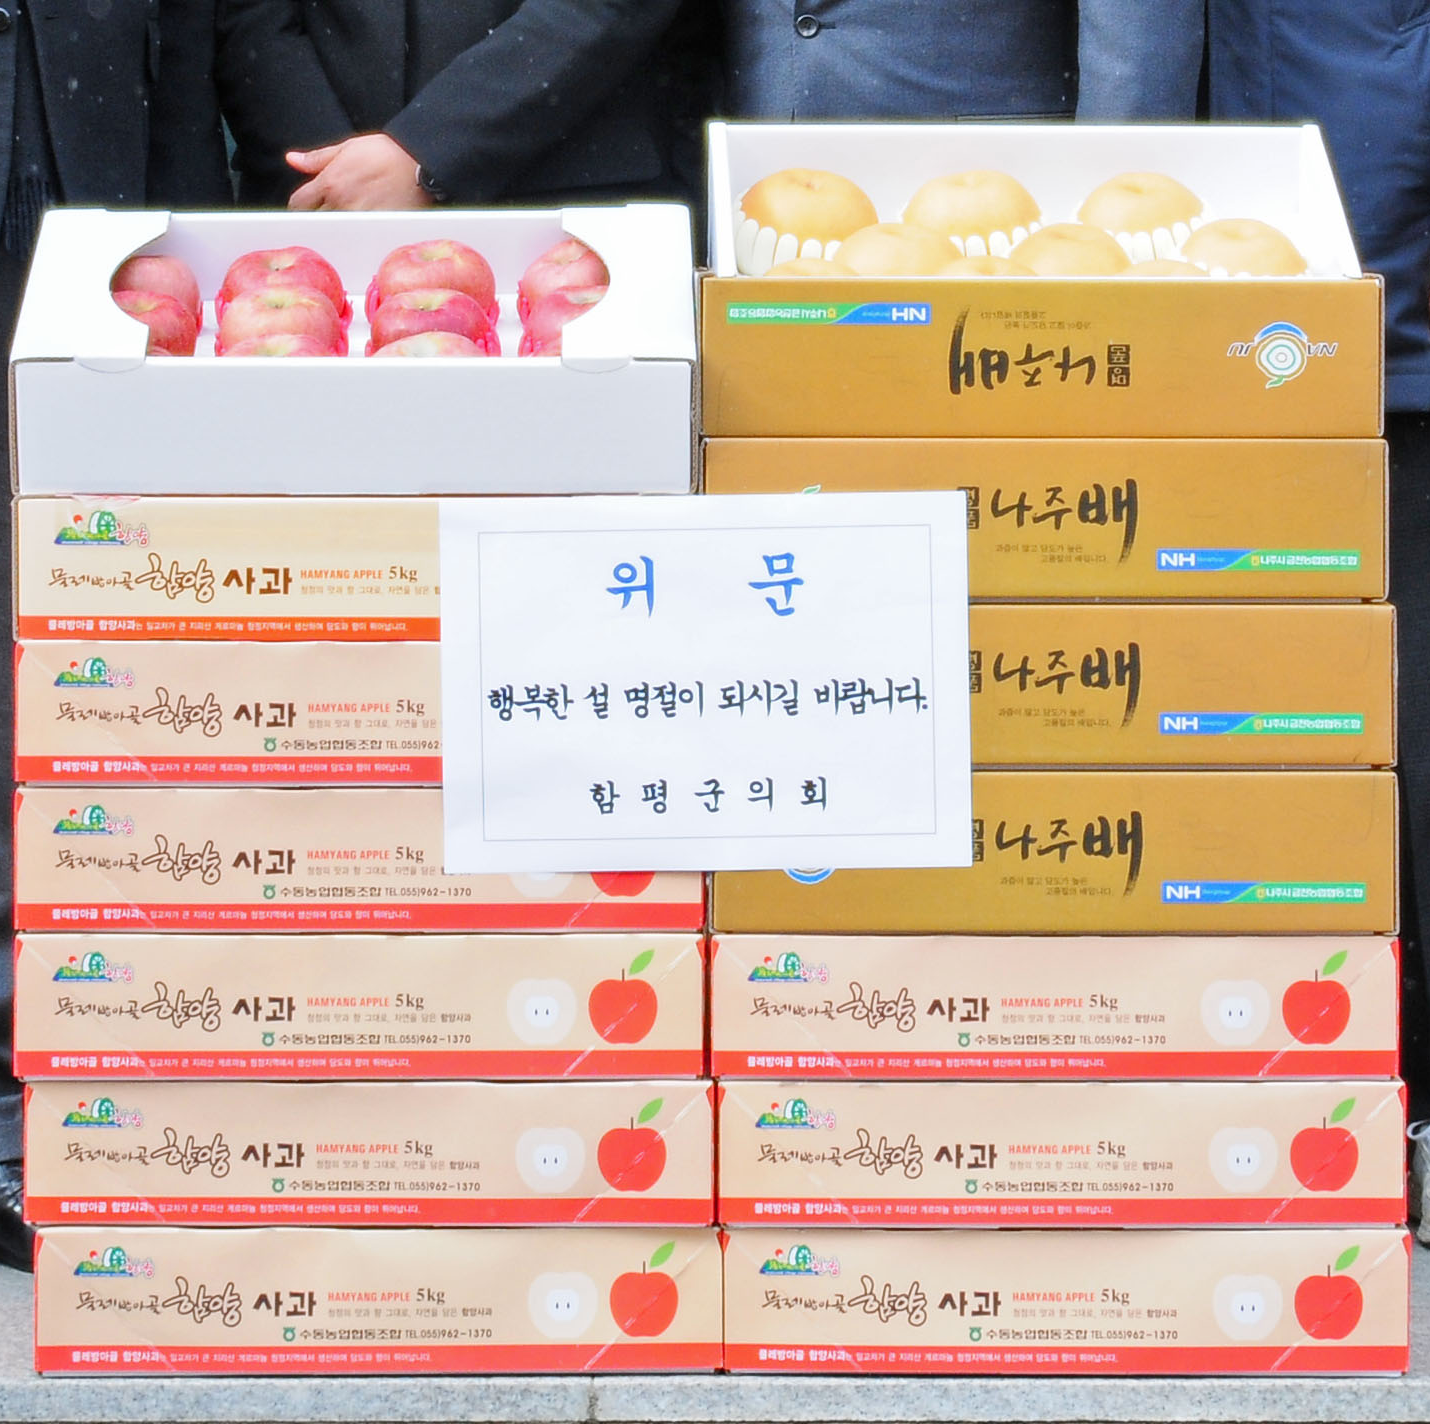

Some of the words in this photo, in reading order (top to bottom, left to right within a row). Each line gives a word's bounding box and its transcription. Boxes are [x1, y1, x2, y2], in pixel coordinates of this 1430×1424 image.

[891, 307, 926, 321] NH
[949, 307, 1096, 395] 나주배
[1106, 343, 1131, 388] 명품
[990, 478, 1138, 566] 나주배
[1160, 552, 1196, 567] NH
[222, 567, 293, 596] 사과
[300, 569, 350, 579] HAMYANG
[353, 569, 384, 579] APPLE
[388, 565, 418, 583] 5kg
[606, 555, 654, 617] 위
[749, 552, 804, 617] 문
[993, 641, 1141, 729] 나주배
[308, 703, 358, 713] HAMYANG
[360, 703, 391, 713] APPLE
[396, 699, 426, 717] 5kg
[487, 683, 574, 722] 행복한
[583, 682, 609, 720] 설
[624, 680, 704, 719] 명절이
[718, 678, 799, 717] 되시길
[813, 676, 928, 715] 바랍니다.
[233, 703, 297, 729] 사과
[1163, 716, 1199, 731] NH
[281, 740, 383, 751] 수동농업협동조합
[589, 780, 620, 815] 함
[642, 778, 668, 815] 평
[694, 778, 725, 813] 군
[747, 777, 774, 811] 의
[800, 776, 827, 811] 회
[232, 850, 296, 876] 사과
[307, 850, 357, 860] HAMYANG
[359, 850, 390, 860] APPLE
[395, 846, 425, 864] 5kg
[995, 810, 1143, 898] 나주배
[280, 887, 382, 898] 수동농업협동조합
[1165, 885, 1201, 900] NH
[232, 997, 296, 1023] 사과
[307, 997, 357, 1007] HAMYANG
[359, 997, 390, 1007] APPLE
[395, 993, 425, 1011] 5kg
[926, 998, 990, 1024] 사과
[1001, 998, 1051, 1008] HAMYANG
[1053, 998, 1084, 1008] APPLE
[1089, 994, 1119, 1012] 5kg
[279, 1034, 381, 1045] 수동농업협동조합
[974, 1034, 1076, 1045] 수동농업협동조합
[241, 1143, 305, 1169] 사과
[316, 1144, 366, 1154] HAMYANG
[368, 1144, 399, 1154] APPLE
[404, 1140, 434, 1158] 5kg
[934, 1144, 998, 1170] 사과
[1009, 1144, 1059, 1154] HAMYANG
[1061, 1144, 1092, 1154] APPLE
[1097, 1141, 1127, 1159] 5kg
[289, 1180, 391, 1191] 수동농업협동조합
[982, 1181, 1084, 1192] 수동농업협동조합
[253, 1292, 317, 1318] 사과
[328, 1292, 378, 1302] HAMYANG
[380, 1292, 411, 1302] APPLE
[416, 1287, 446, 1305] 5kg
[938, 1292, 1002, 1318] 사과
[1013, 1292, 1063, 1302] HAMYANG
[1065, 1292, 1096, 1302] APPLE
[1101, 1288, 1131, 1306] 5kg
[300, 1329, 402, 1340] 수동농업협동조합
[986, 1329, 1088, 1340] 수동농업협동조합
